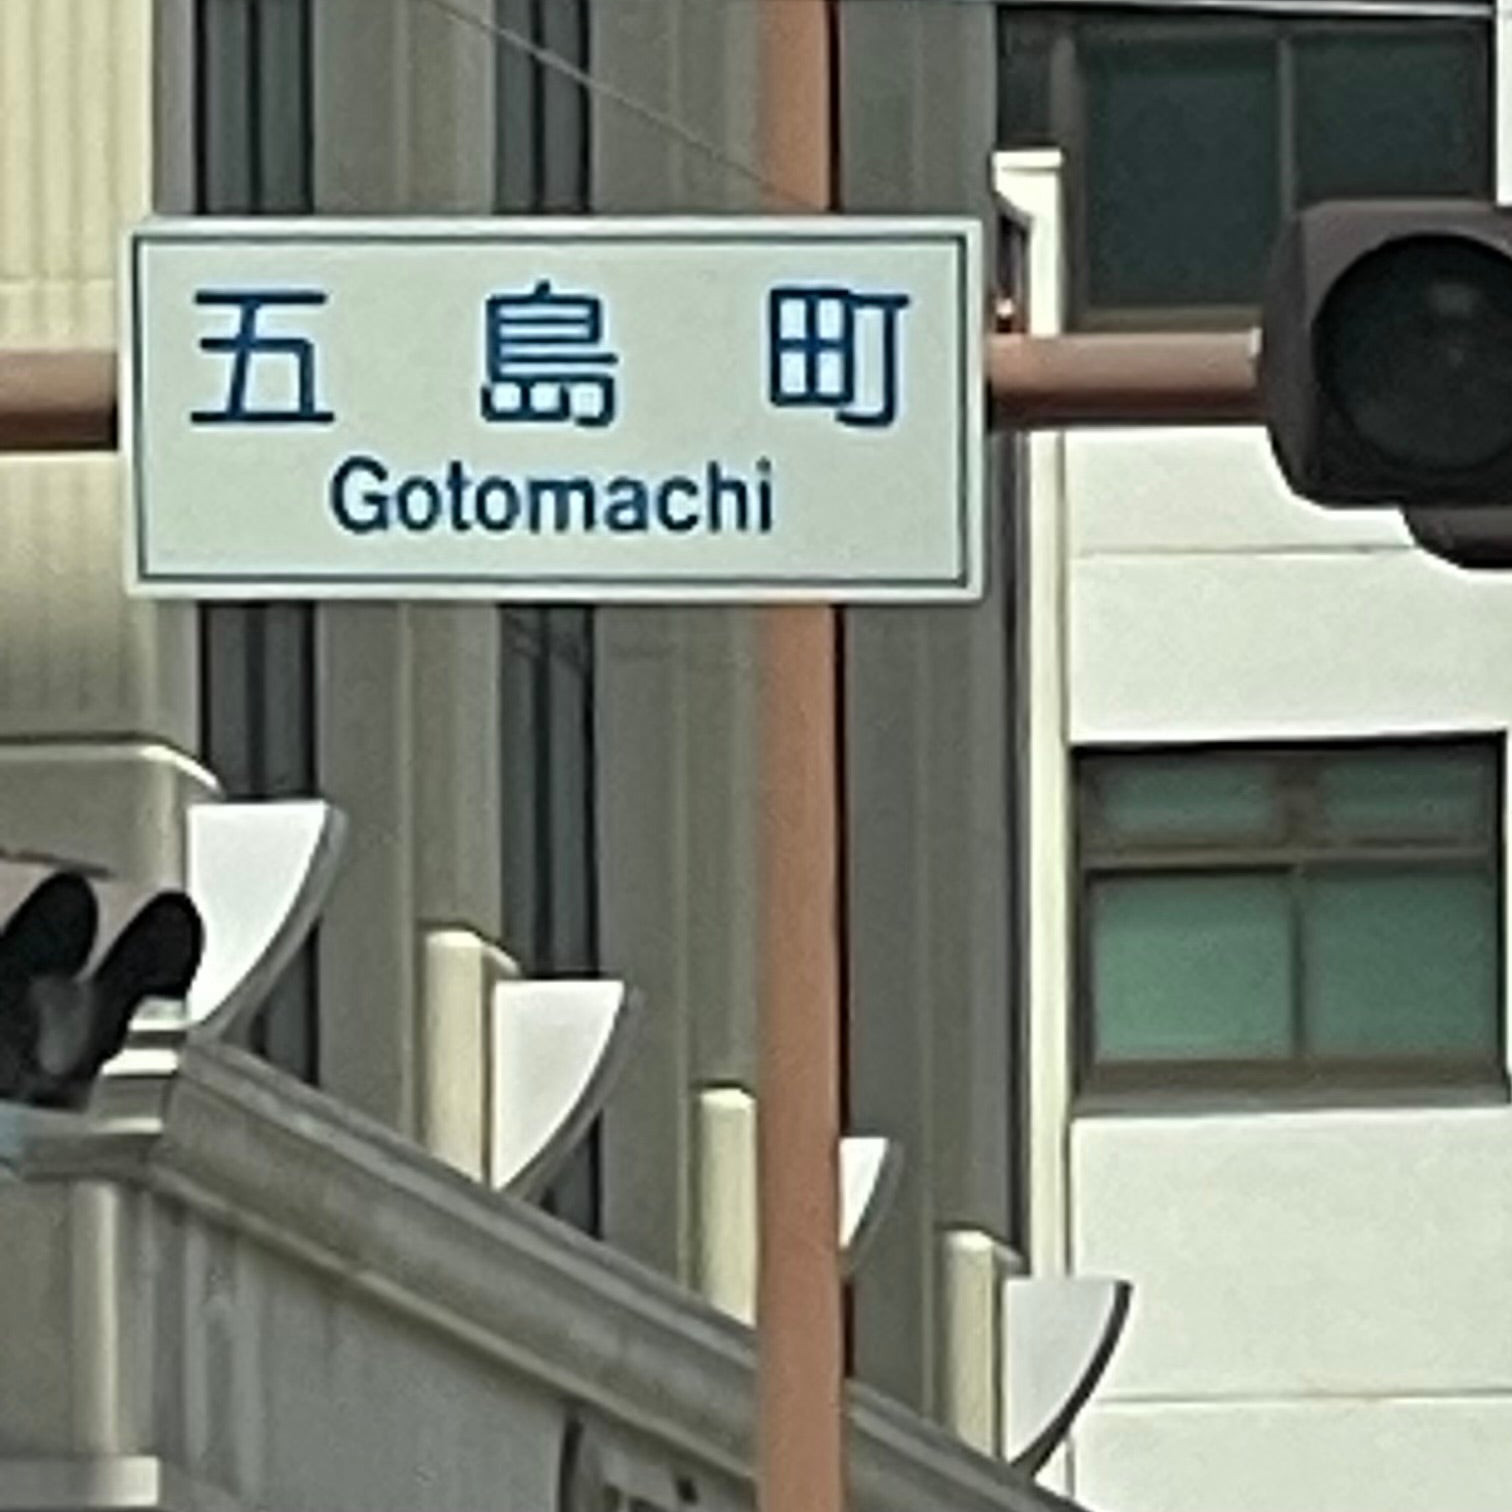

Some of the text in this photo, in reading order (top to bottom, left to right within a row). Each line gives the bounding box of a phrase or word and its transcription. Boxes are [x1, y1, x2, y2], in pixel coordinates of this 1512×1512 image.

[189, 278, 912, 429] 五島町
[329, 454, 774, 535] Gotomachi
